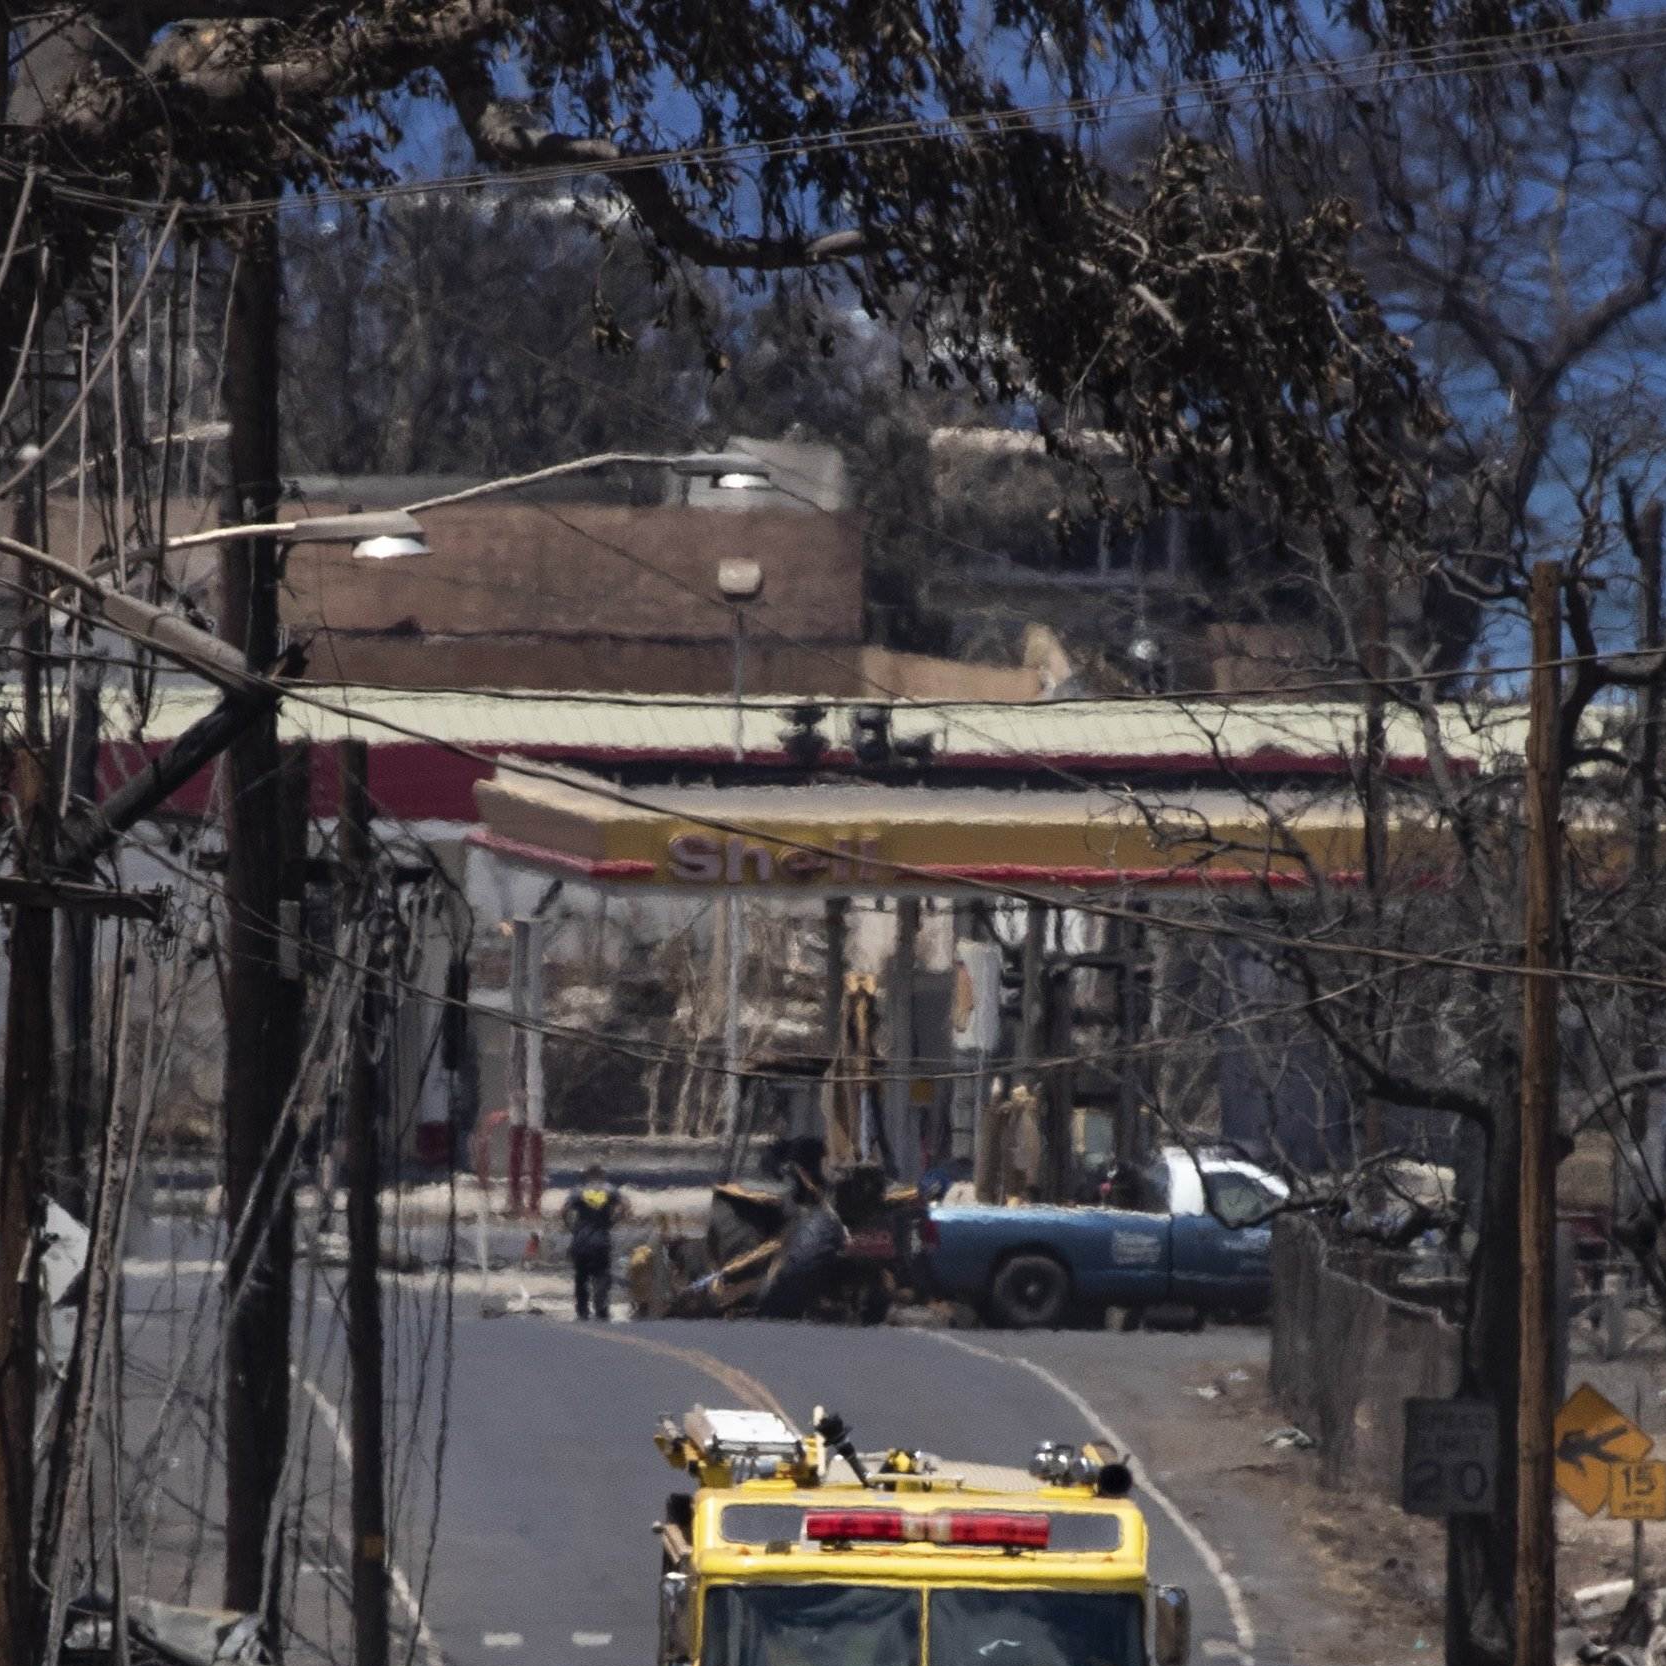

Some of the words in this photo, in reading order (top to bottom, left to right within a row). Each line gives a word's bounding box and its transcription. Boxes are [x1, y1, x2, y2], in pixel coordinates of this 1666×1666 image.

[668, 833, 879, 882] Shell
[1413, 1412, 1492, 1431] SPEED
[1421, 1436, 1484, 1454] LIMIT
[1412, 1460, 1488, 1502] 20
[1622, 1465, 1657, 1497] 15
